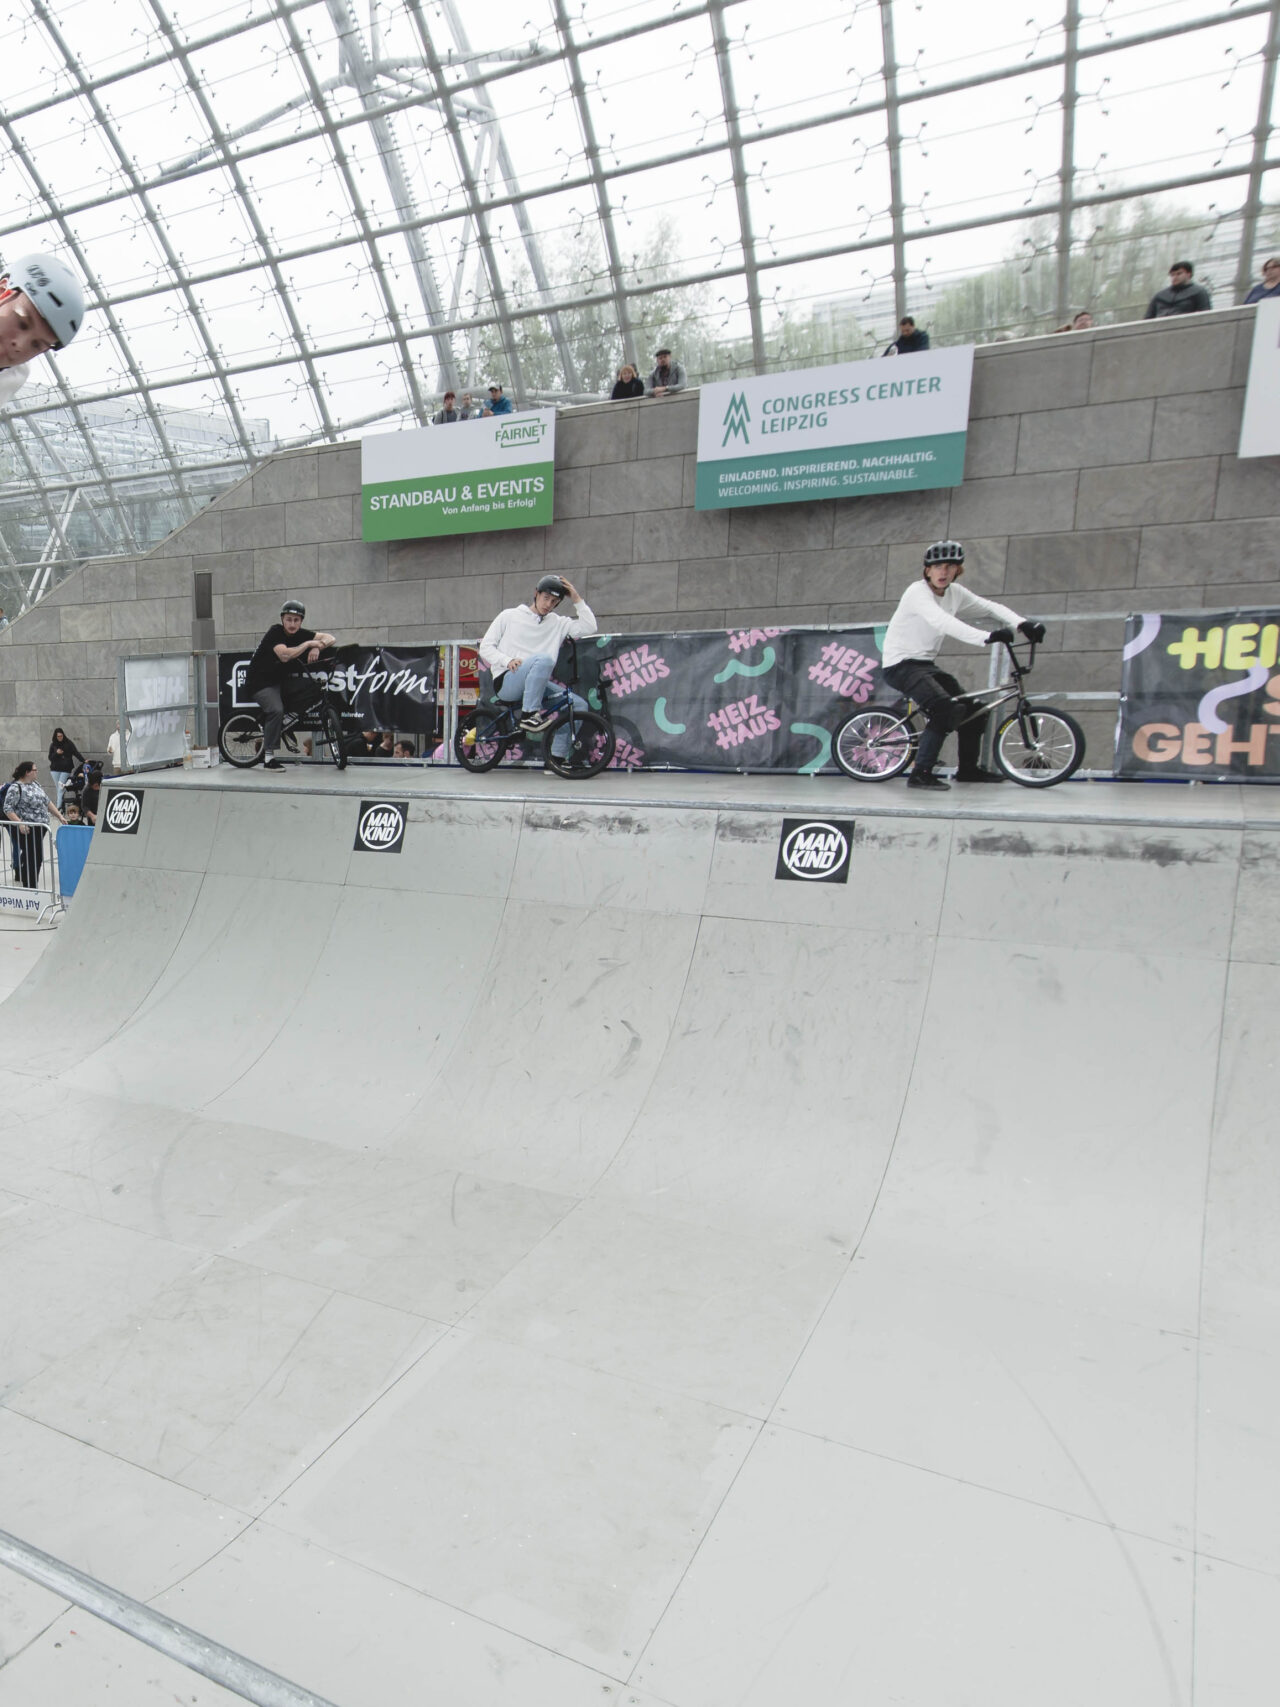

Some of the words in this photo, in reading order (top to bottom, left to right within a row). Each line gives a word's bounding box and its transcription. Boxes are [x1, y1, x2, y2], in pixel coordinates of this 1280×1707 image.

[762, 387, 860, 416] CONGRESS
[866, 376, 942, 401] CENTER
[495, 424, 547, 442] FAIRNET
[761, 411, 828, 435] LEIPZIG
[719, 468, 779, 483] EINLADEND.
[781, 459, 860, 477] INSPIRIEREND.
[862, 451, 937, 468] NACHHALTIG.
[370, 487, 457, 511] STANDBAU
[461, 485, 473, 500] &
[477, 477, 545, 499] EVENTS
[718, 482, 781, 497] WELCOMING.
[784, 476, 840, 490] INSPIRING.
[842, 468, 918, 485] SUSTAINABLE.
[442, 507, 458, 515] Von
[461, 503, 490, 513] Anfang
[493, 501, 505, 510] bis
[508, 497, 537, 509] Erfolg!
[603, 643, 657, 680] HEIZ
[1167, 623, 1280, 670] HEI
[821, 642, 879, 682] HEIZ
[610, 658, 670, 698] HAUS
[808, 661, 874, 703] HAUS
[707, 694, 767, 731] HEIZ
[716, 709, 781, 750] HAUS
[1132, 722, 1280, 766] GEH
[109, 811, 133, 825] KIND
[112, 799, 137, 812] MAN
[367, 811, 400, 827] MAN
[363, 826, 395, 842] KIND
[793, 831, 842, 852] MAN
[787, 850, 836, 869] KIND
[26, 900, 40, 911] Auf
